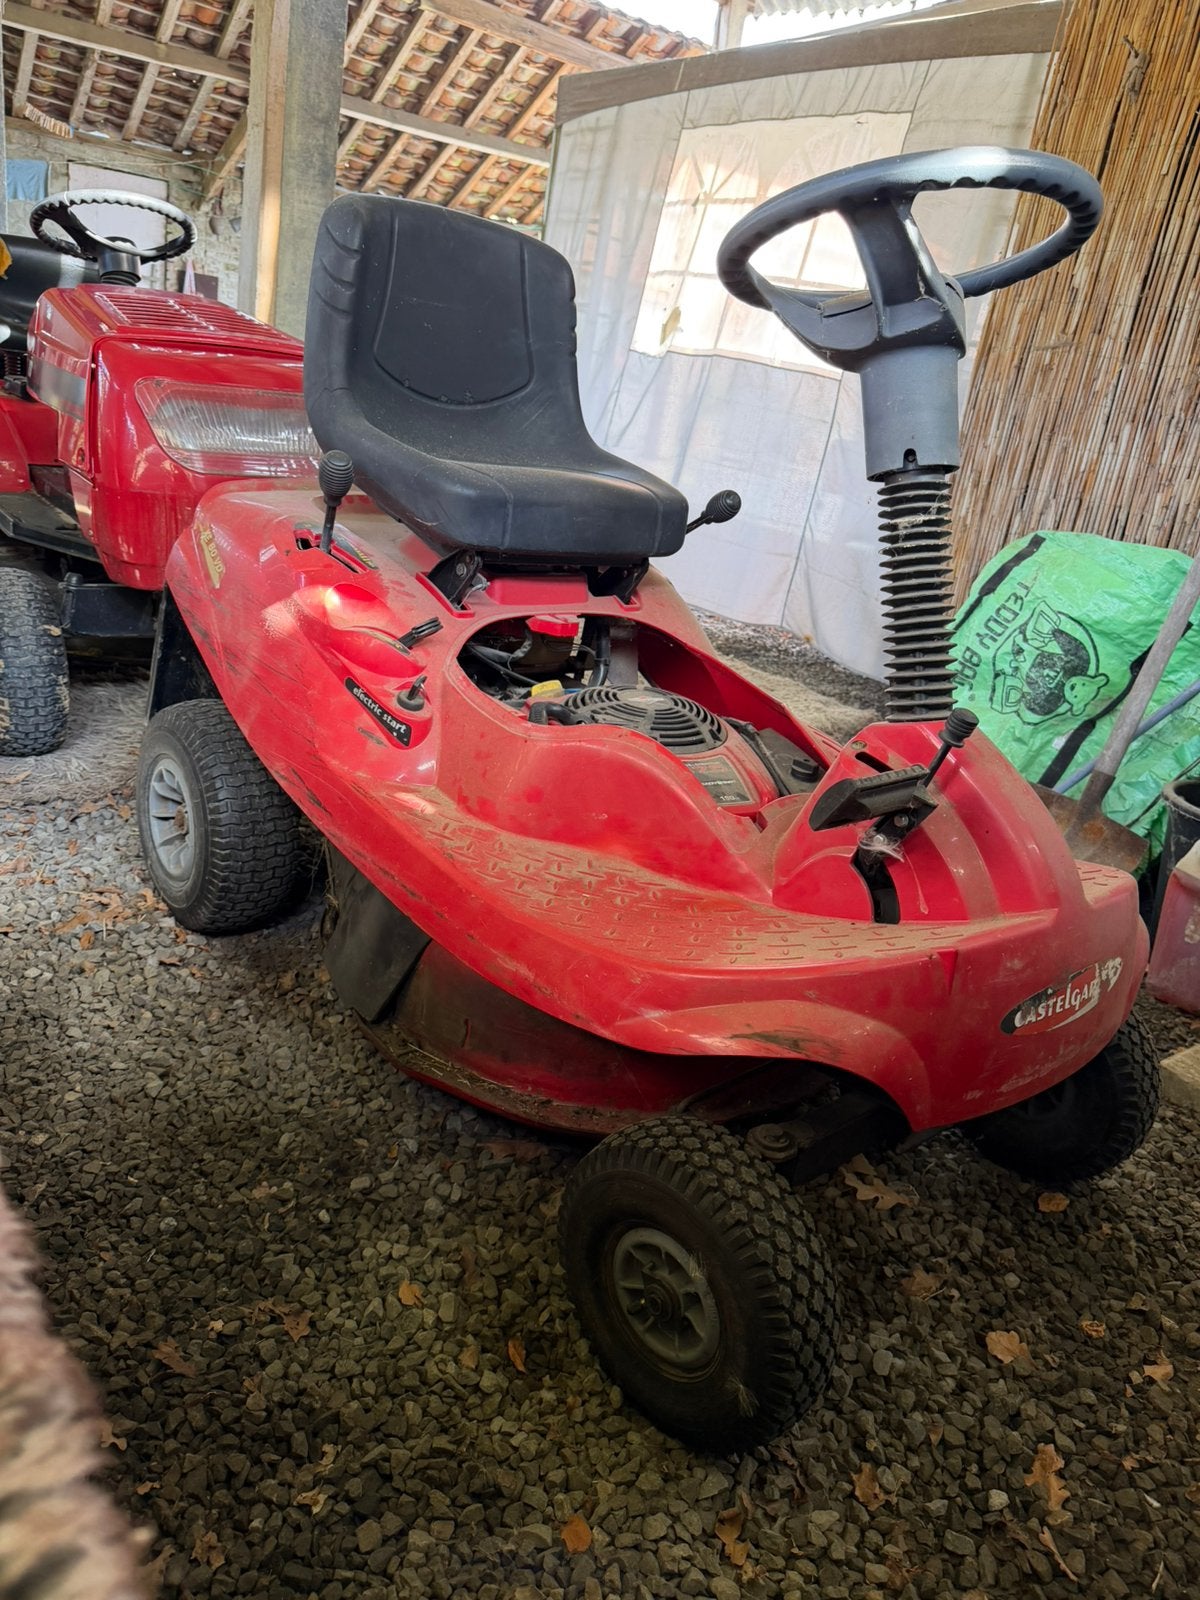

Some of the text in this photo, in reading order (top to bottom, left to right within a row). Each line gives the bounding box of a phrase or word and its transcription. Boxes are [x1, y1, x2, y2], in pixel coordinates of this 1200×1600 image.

[952, 576, 1034, 691] TEDDY BAG
[353, 687, 407, 733] electric start
